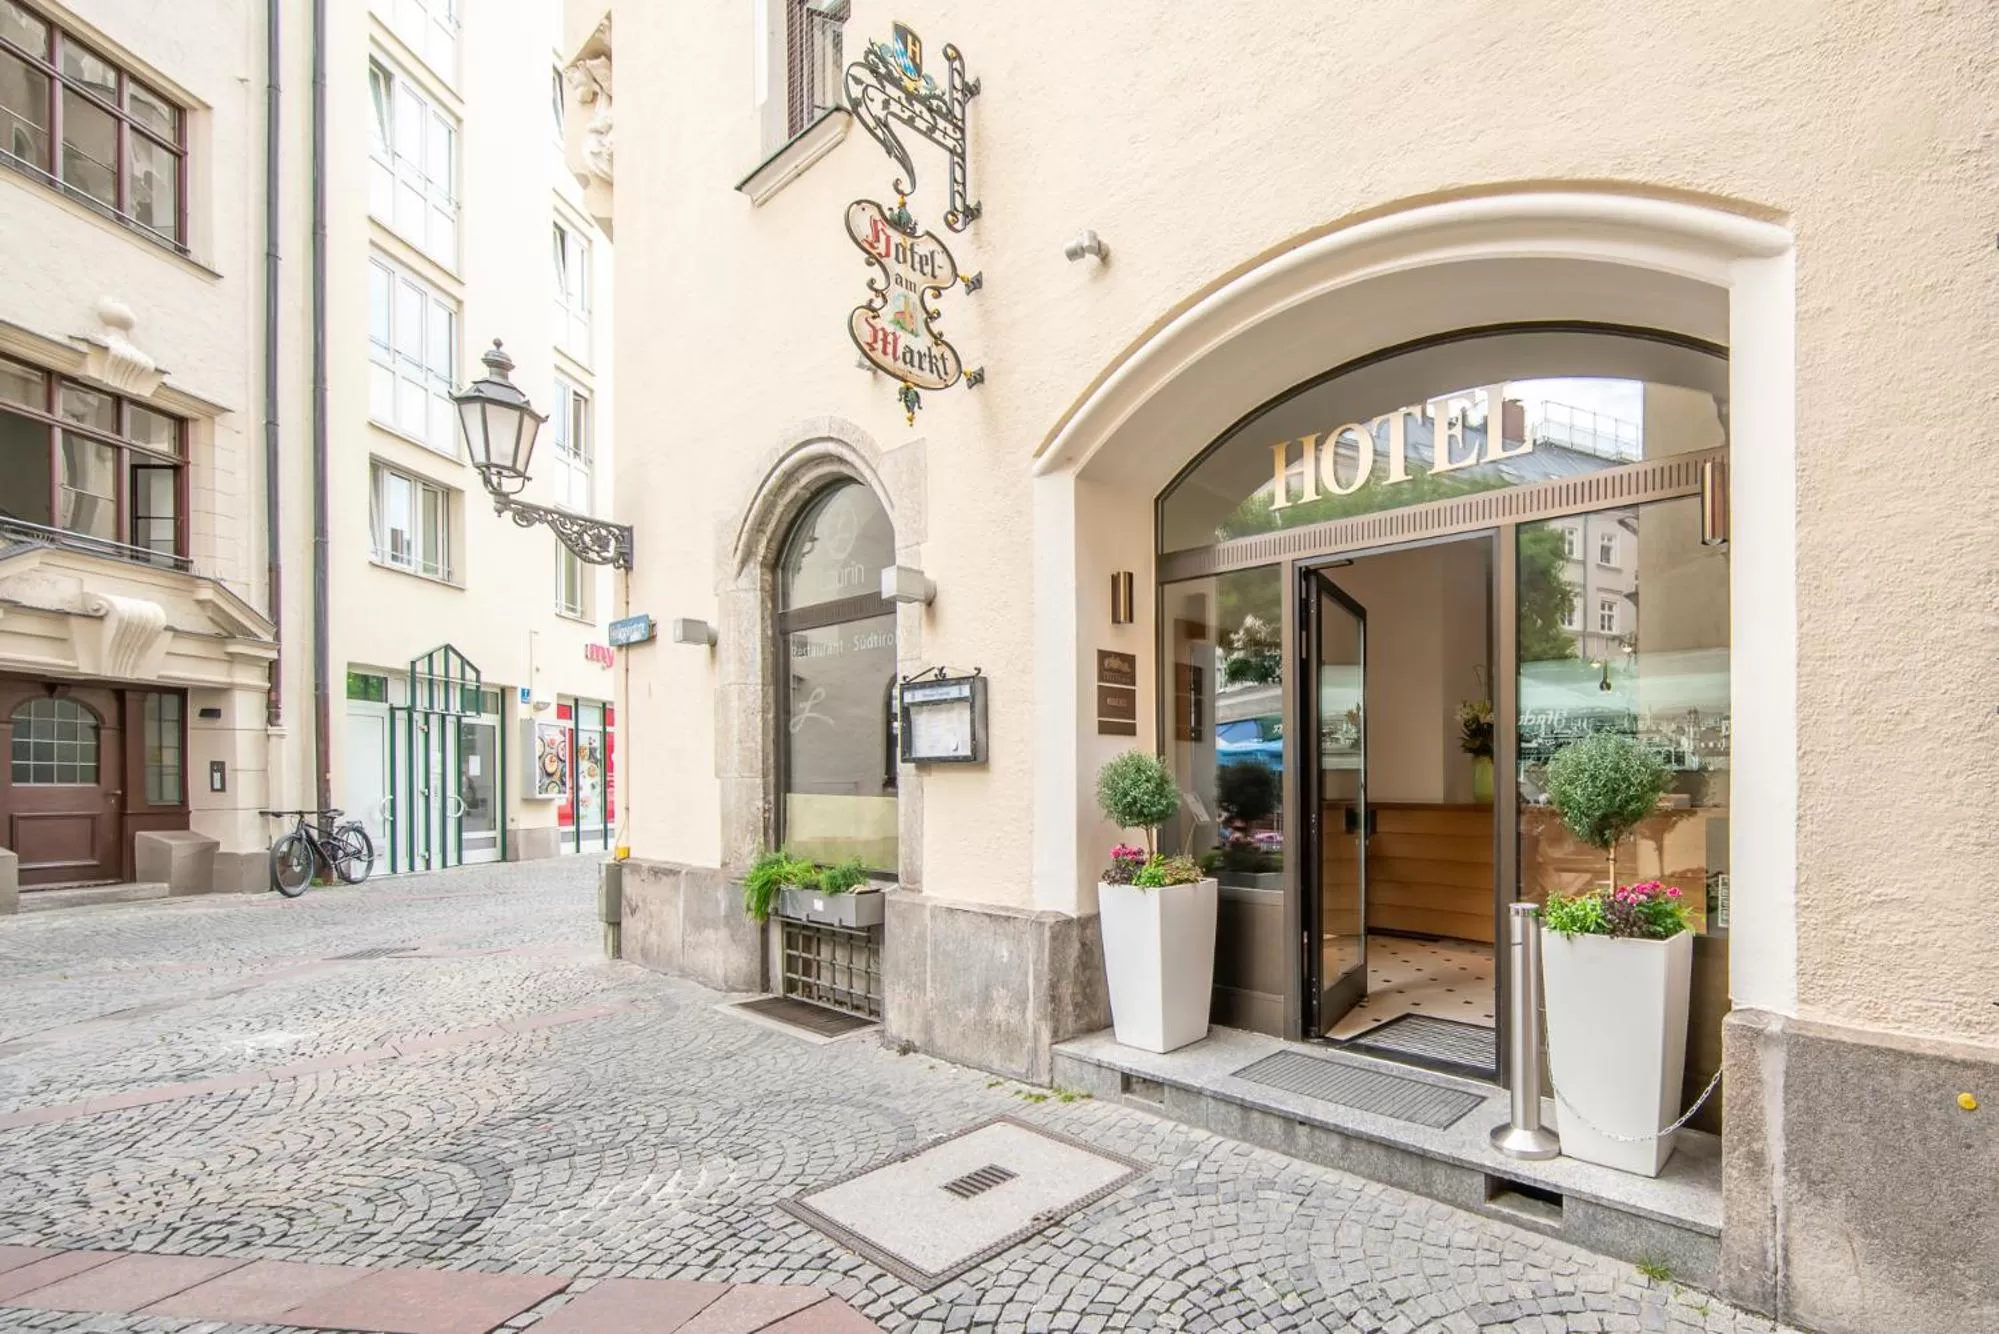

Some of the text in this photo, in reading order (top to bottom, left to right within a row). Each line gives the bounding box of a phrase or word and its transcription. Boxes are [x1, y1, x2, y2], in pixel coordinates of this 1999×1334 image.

[906, 33, 921, 64] H
[894, 272, 918, 294] am
[865, 316, 950, 381] Markt
[1269, 381, 1537, 511] HOTEL
